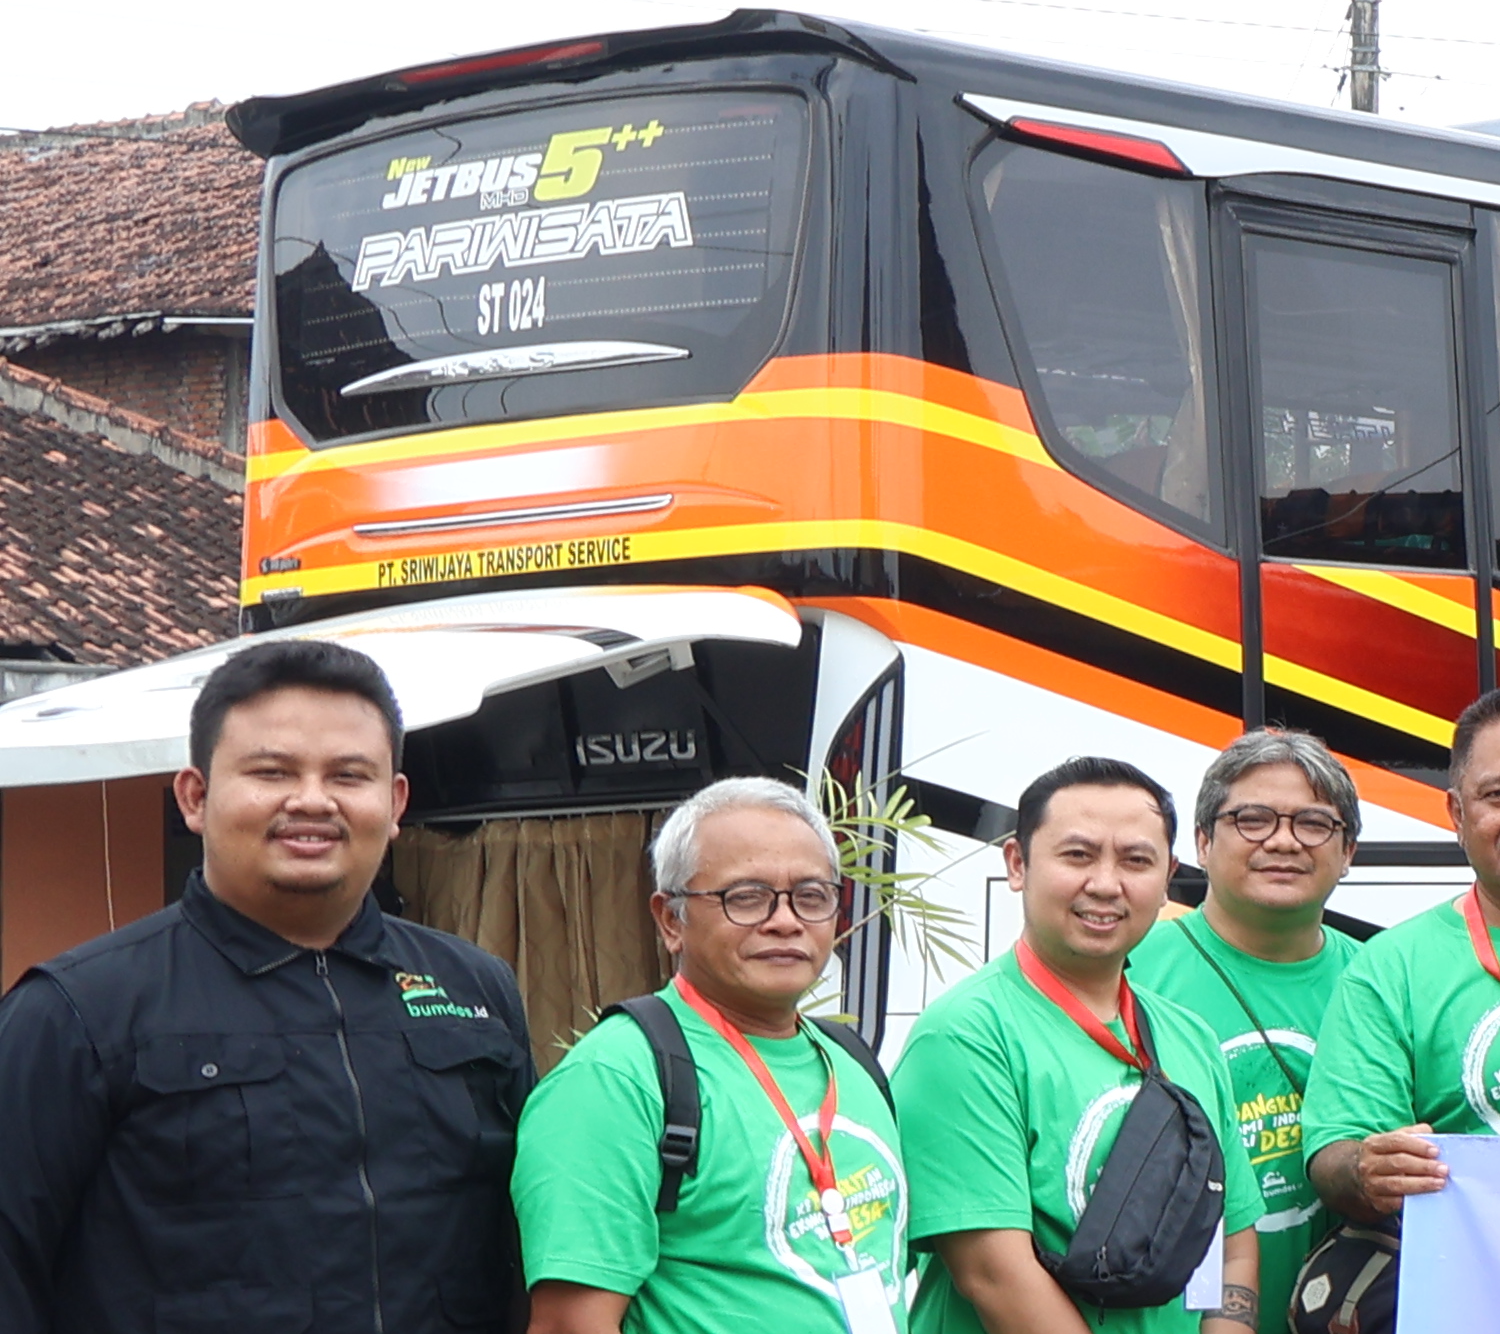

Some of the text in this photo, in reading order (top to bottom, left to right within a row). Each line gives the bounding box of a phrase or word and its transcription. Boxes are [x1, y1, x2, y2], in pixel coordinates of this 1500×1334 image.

[382, 153, 543, 210] JETBUS
[386, 155, 431, 181] New
[352, 191, 694, 292] PARIWISATA
[477, 275, 546, 335] ST 024
[378, 536, 632, 588] PT. SRIWIJAYA TRANSPORT SERVICE
[576, 729, 697, 766] ISUZU
[1260, 1124, 1302, 1154] DES
